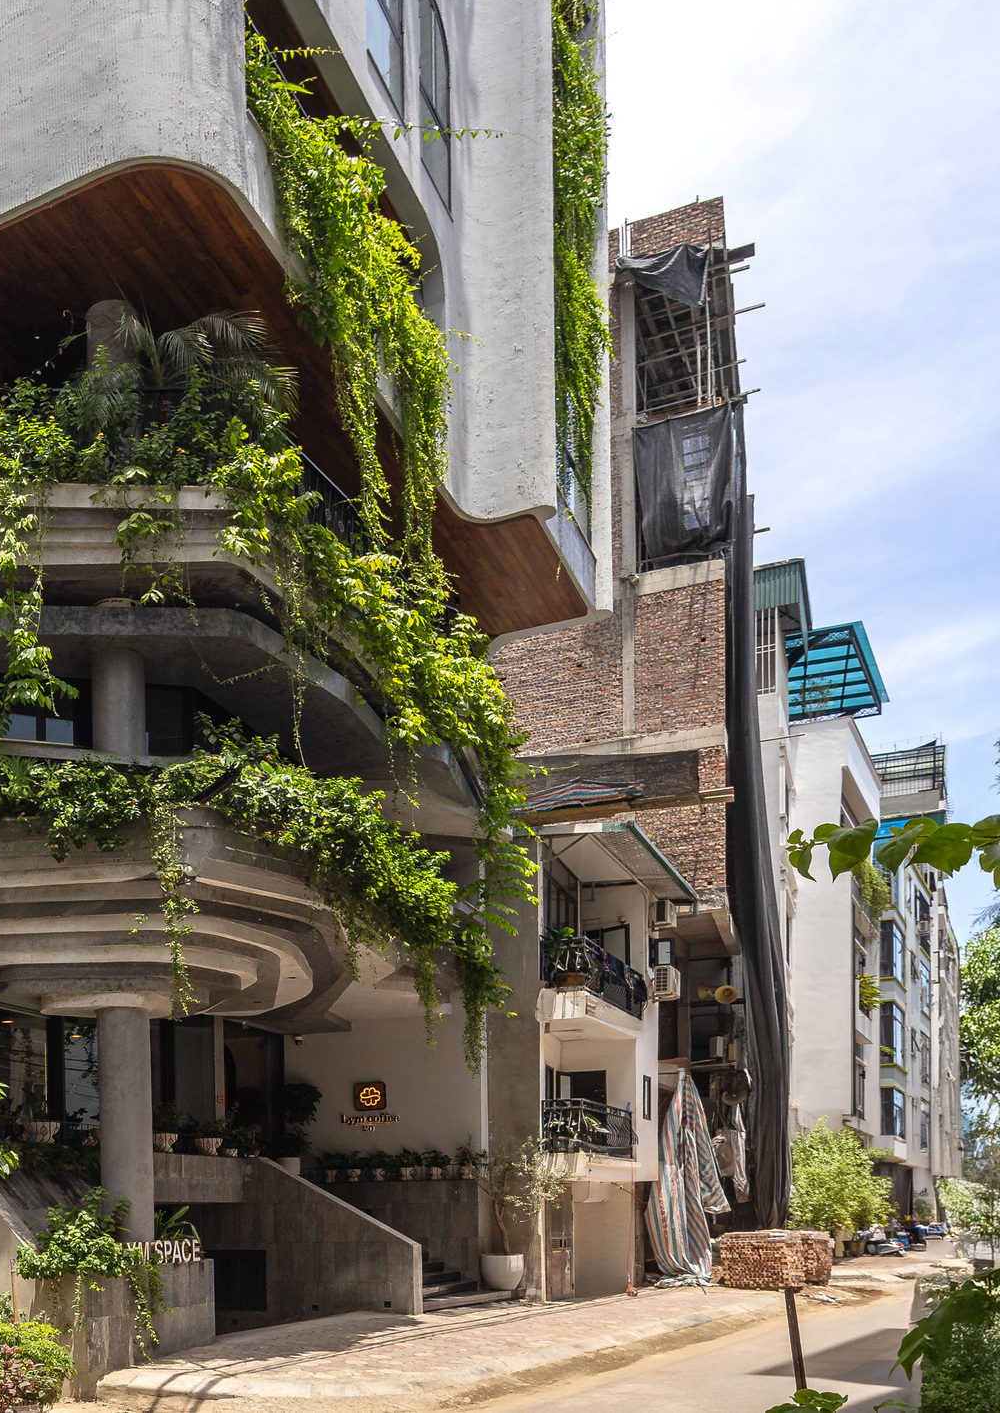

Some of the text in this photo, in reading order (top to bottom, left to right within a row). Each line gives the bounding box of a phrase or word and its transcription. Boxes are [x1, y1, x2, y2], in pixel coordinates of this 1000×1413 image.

[341, 1112, 400, 1125] Lym coffee
[154, 1238, 201, 1264] SPACE
